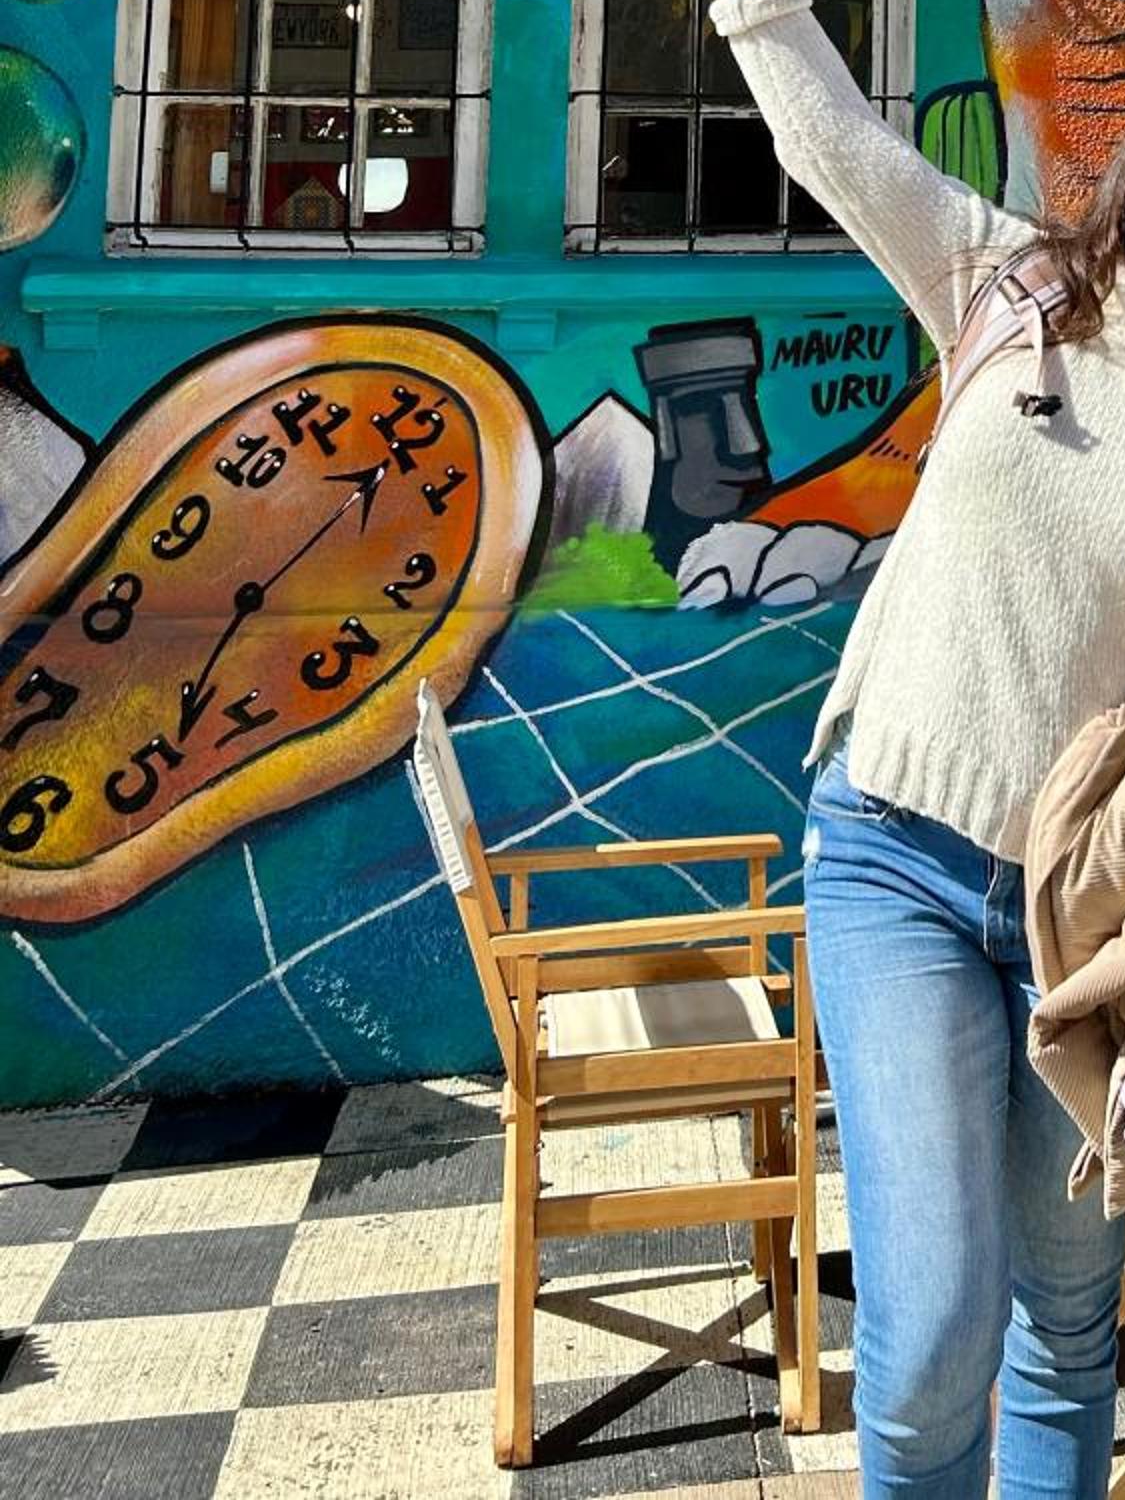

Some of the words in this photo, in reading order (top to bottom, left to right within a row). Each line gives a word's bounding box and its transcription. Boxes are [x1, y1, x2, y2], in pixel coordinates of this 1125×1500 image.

[272, 387, 351, 457] 11
[370, 385, 445, 474] 12
[811, 372, 893, 417] URU
[215, 433, 287, 489] 10
[421, 465, 468, 516] 1
[151, 494, 211, 561] 9
[82, 572, 143, 644] 8
[383, 553, 437, 610] 2
[300, 615, 380, 691] 3
[0, 666, 80, 750] 7
[213, 689, 279, 750] 4
[104, 733, 186, 815] 5
[0, 773, 73, 852] 6
